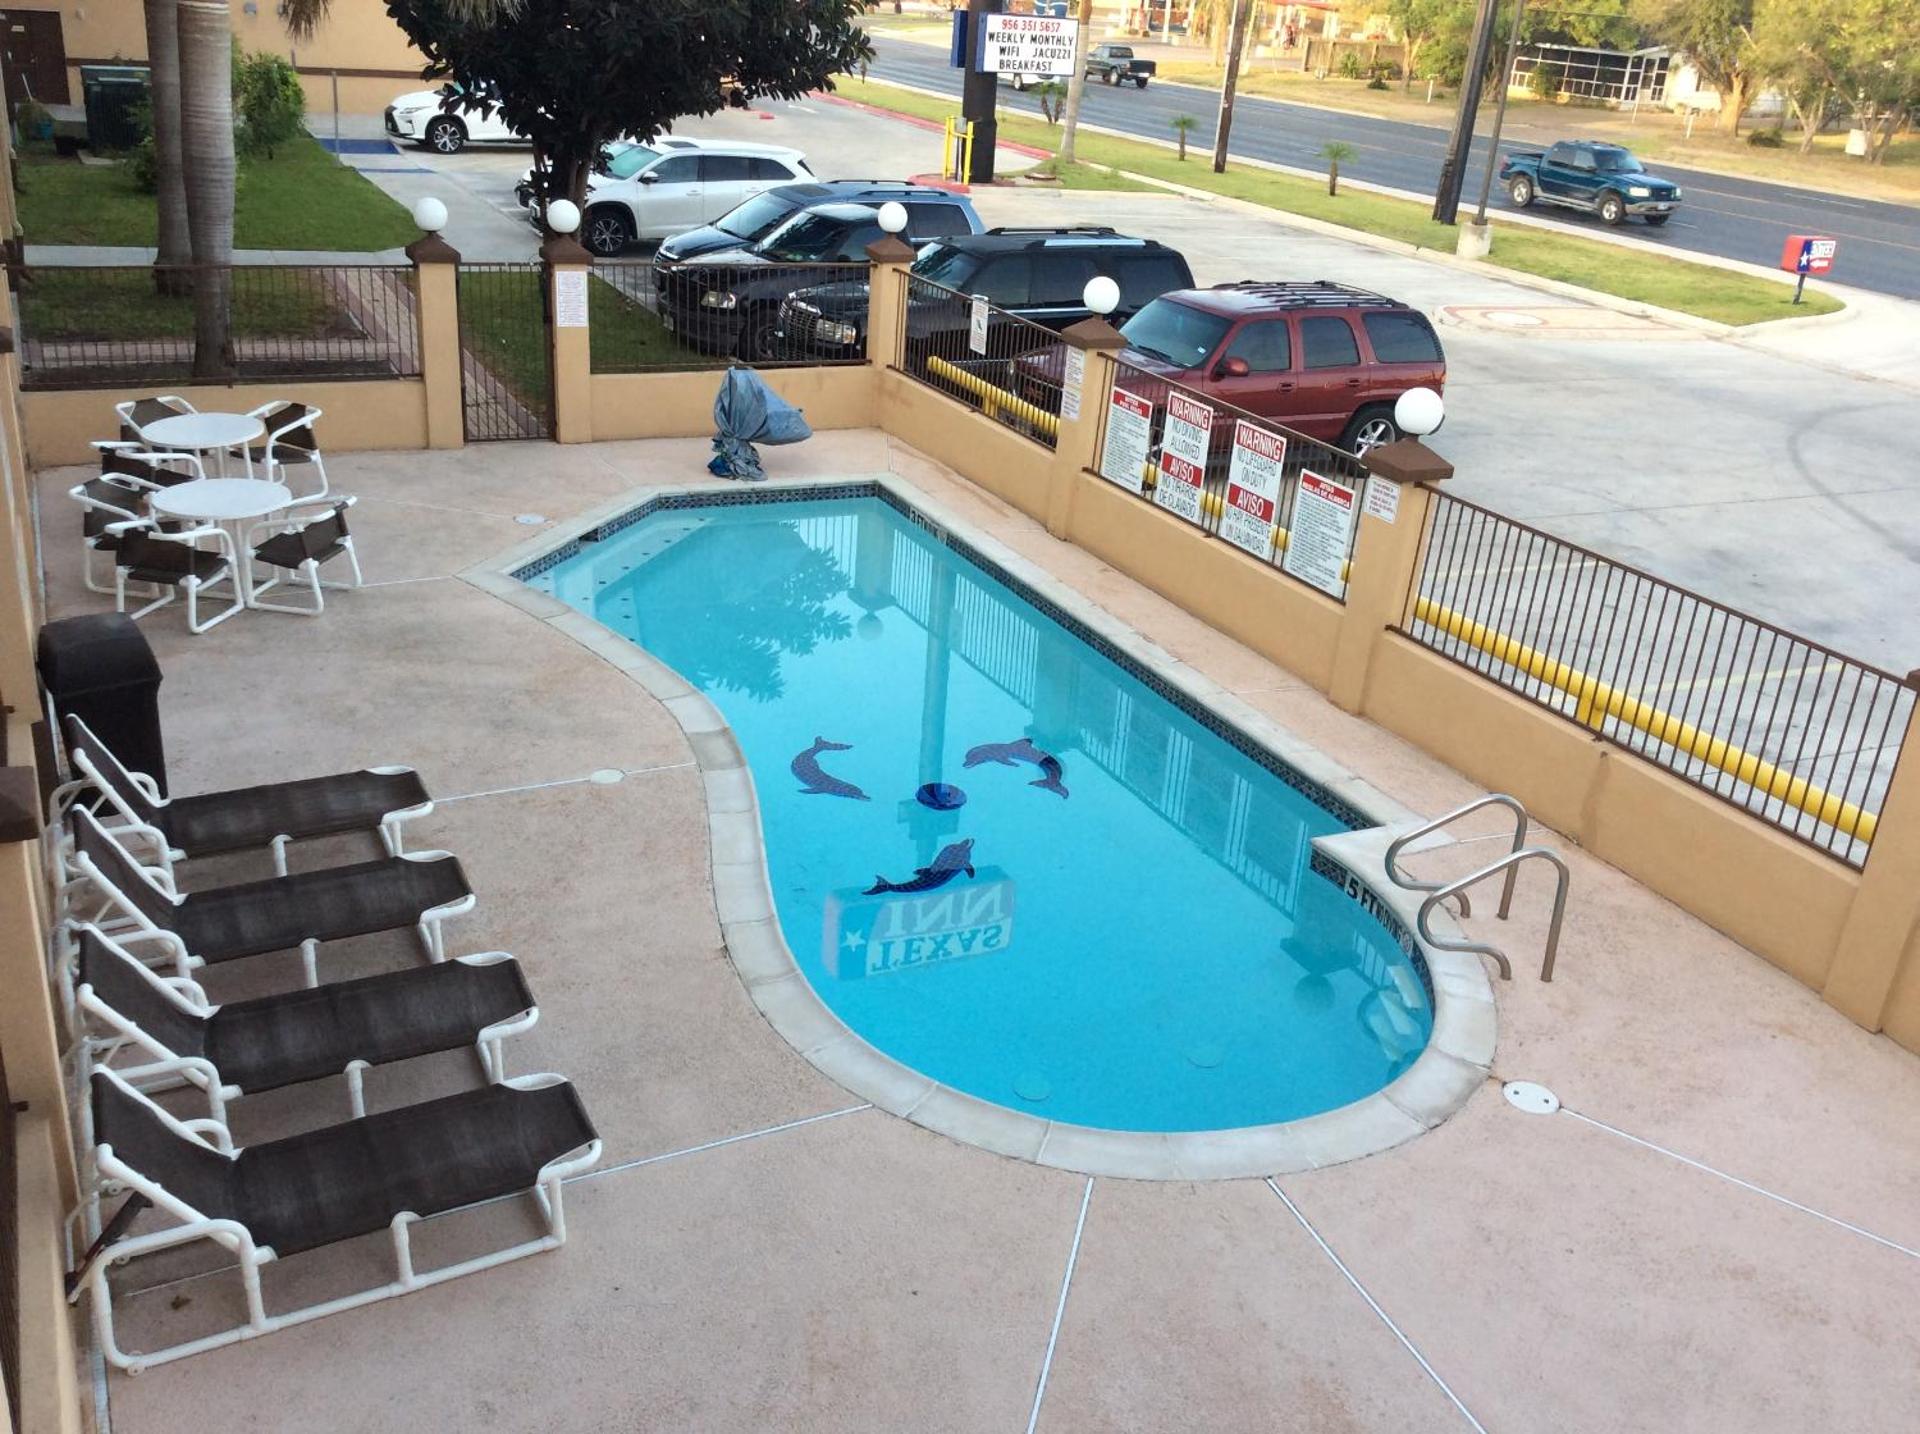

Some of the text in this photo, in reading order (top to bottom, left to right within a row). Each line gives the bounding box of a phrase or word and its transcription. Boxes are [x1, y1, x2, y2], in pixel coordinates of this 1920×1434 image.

[988, 31, 1074, 46] WEEKLY MONTHLY
[1002, 19, 1061, 33] 956 351 5657
[999, 45, 1071, 59] WIFI JACUZZI
[999, 59, 1052, 71] BREAKFAST
[1171, 397, 1209, 428] WARNING
[1170, 435, 1200, 460] ALLOWED
[1240, 425, 1281, 460] WARNING
[1169, 458, 1194, 483] AVISO
[1237, 490, 1264, 517] AVISO
[1347, 877, 1378, 914] 5 FT
